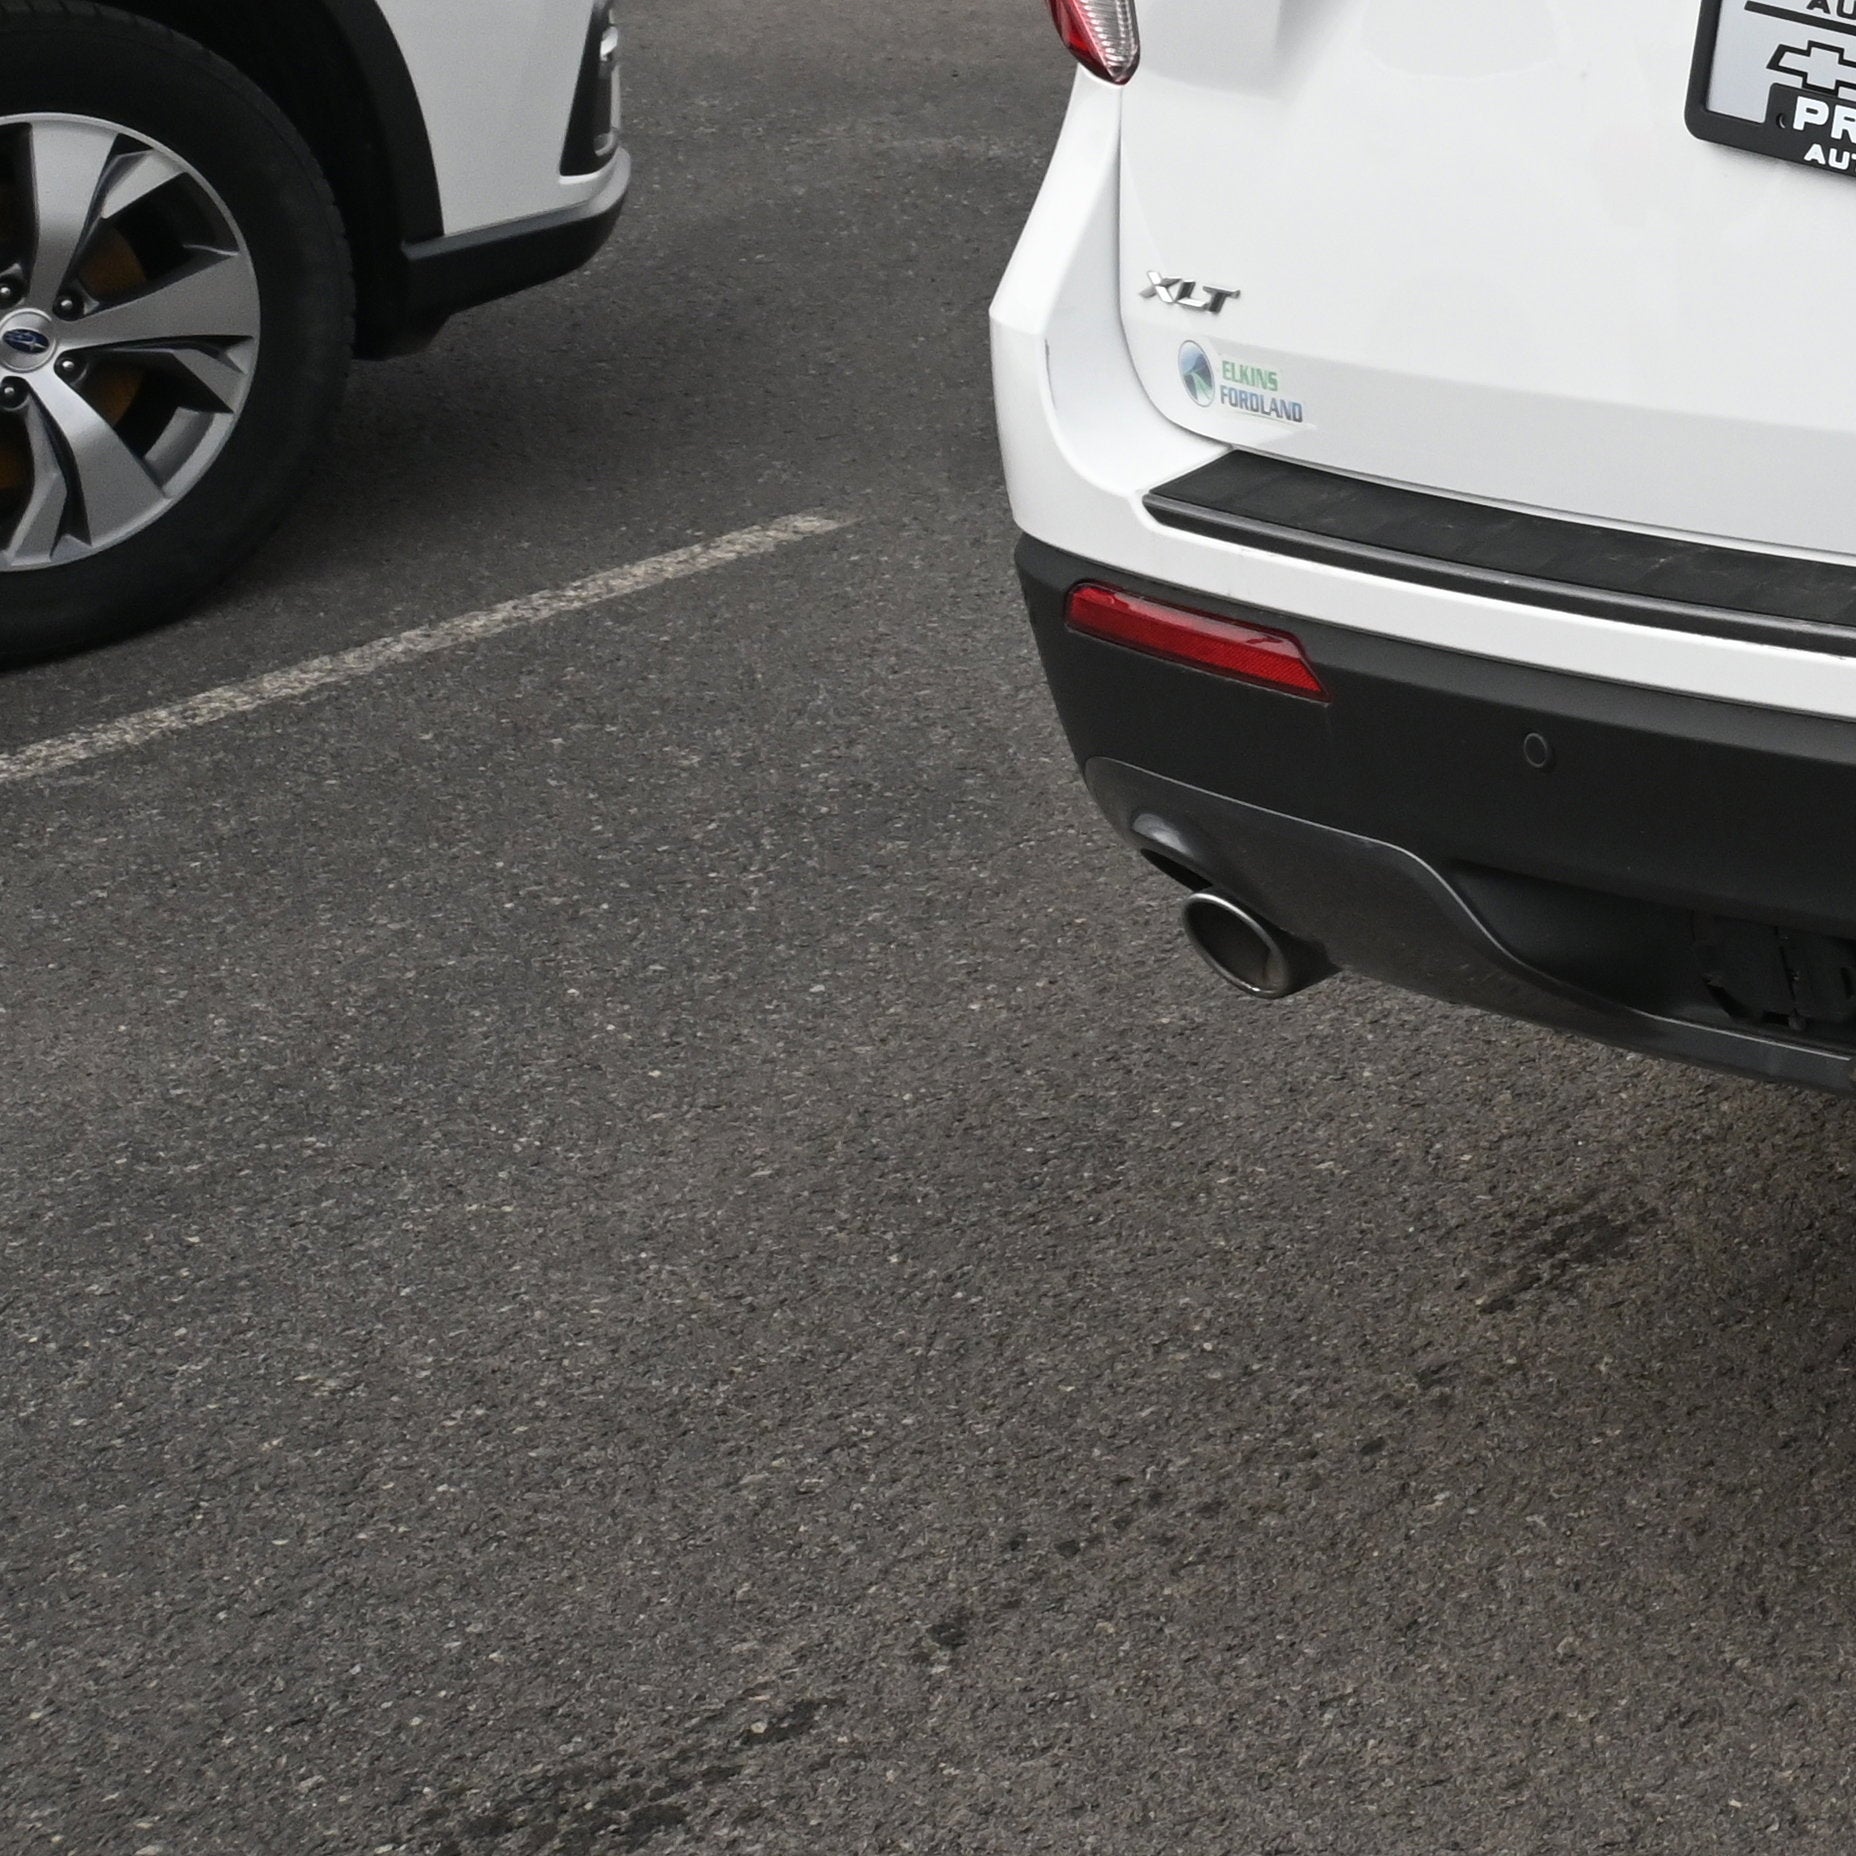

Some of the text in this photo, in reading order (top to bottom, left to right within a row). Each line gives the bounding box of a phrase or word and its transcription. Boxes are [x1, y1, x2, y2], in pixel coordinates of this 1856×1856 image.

[1138, 270, 1241, 314] XLT
[1221, 360, 1279, 392] ELKINS
[1219, 384, 1304, 423] FORDLAND
